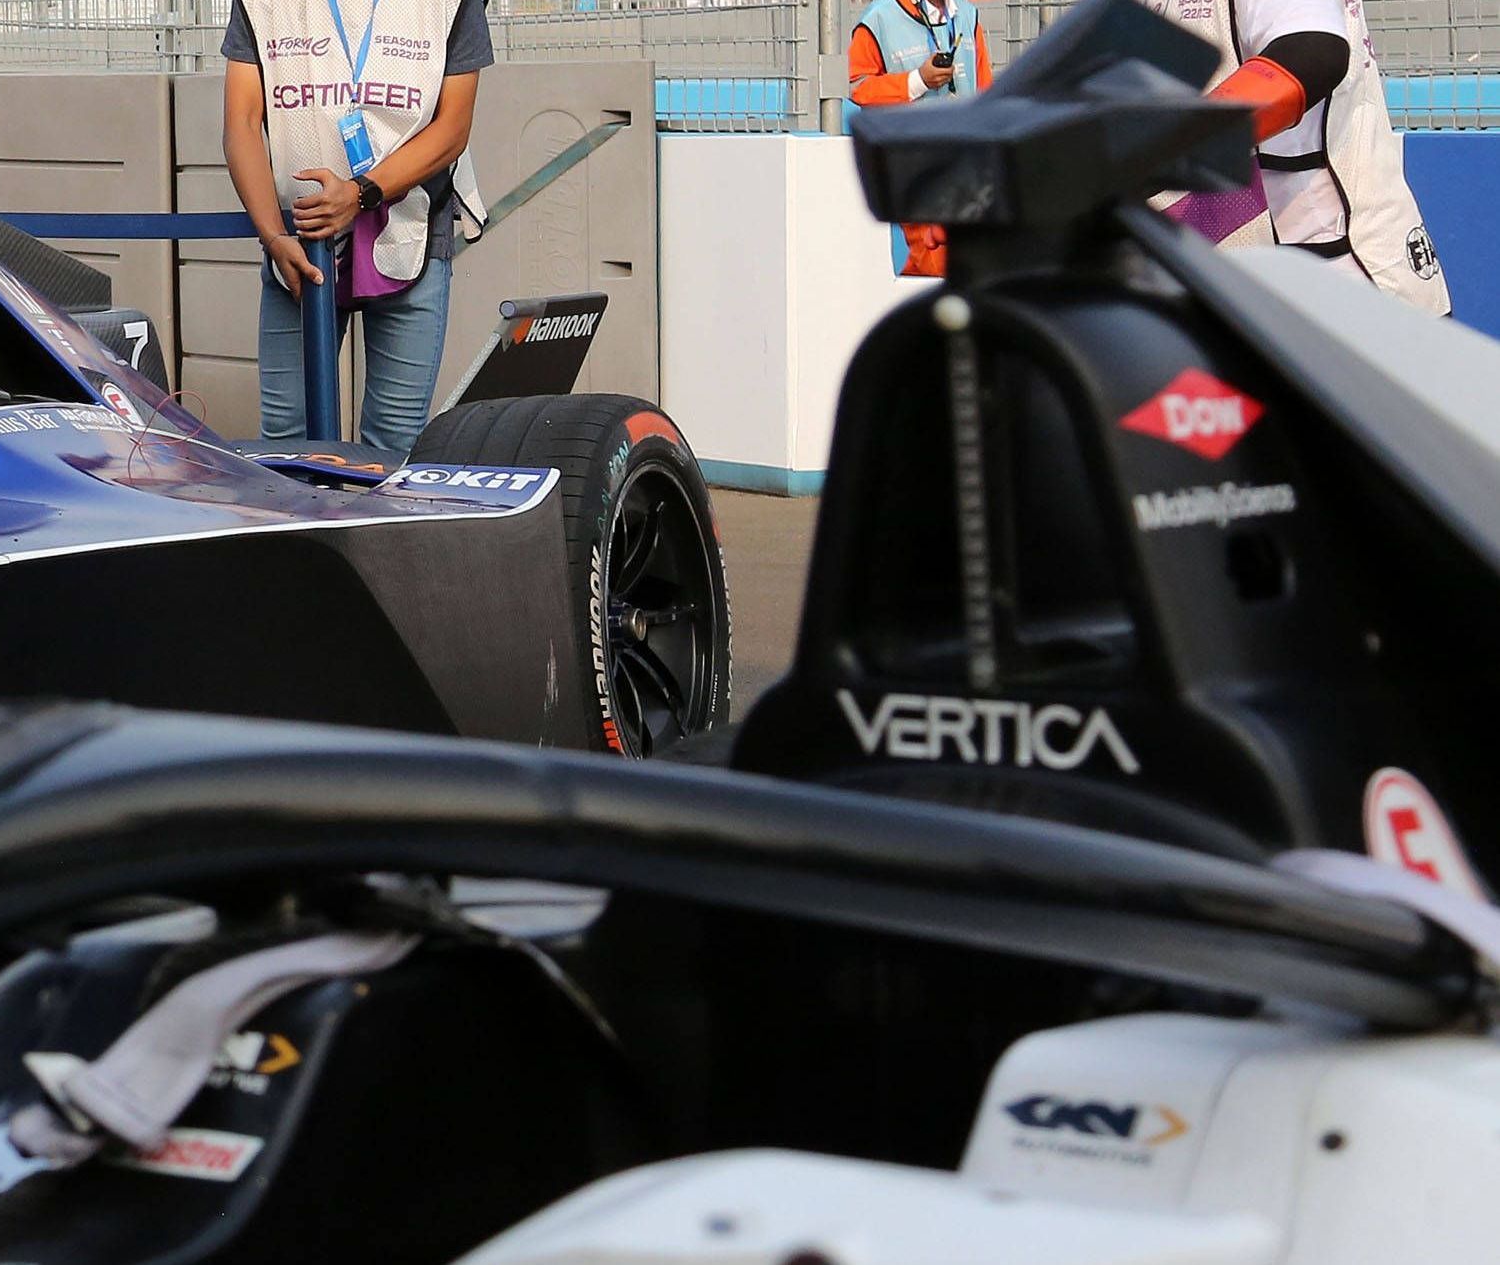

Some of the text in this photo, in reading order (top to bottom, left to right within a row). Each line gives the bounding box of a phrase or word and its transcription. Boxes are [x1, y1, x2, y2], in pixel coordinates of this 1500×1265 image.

[375, 35, 421, 48] SEASON
[382, 47, 430, 61] 2022/23
[525, 311, 600, 343] Hankook
[122, 320, 149, 371] 7
[14, 408, 60, 432] Bär
[836, 687, 1142, 776] VERTICA
